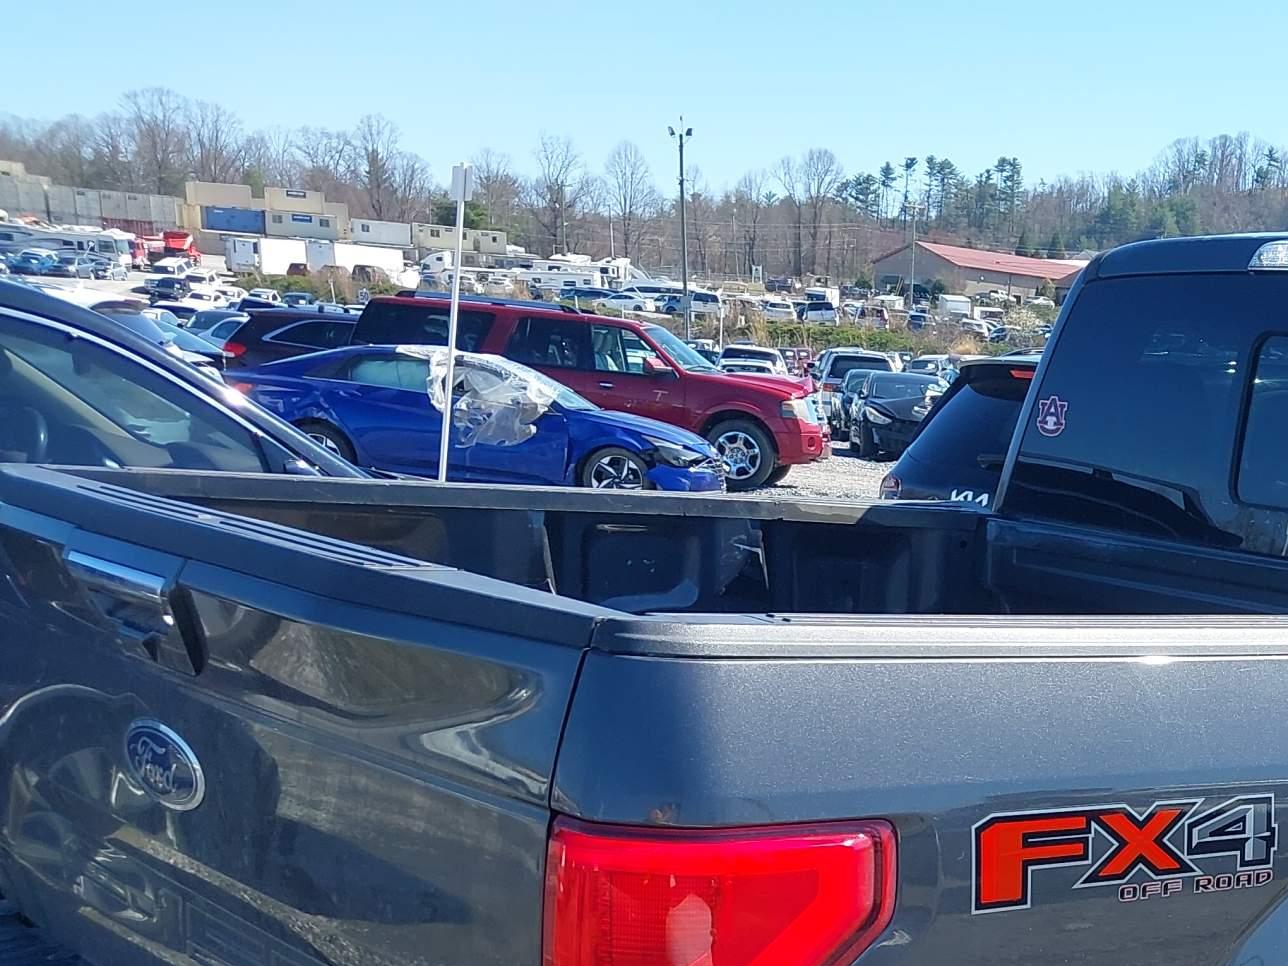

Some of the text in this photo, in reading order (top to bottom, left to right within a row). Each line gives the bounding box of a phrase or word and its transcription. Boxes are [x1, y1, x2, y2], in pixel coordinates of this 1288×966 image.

[950, 489, 989, 507] KIA
[129, 736, 178, 793] Ford
[971, 793, 1278, 915] FX4
[1118, 869, 1273, 902] OFF ROAD
